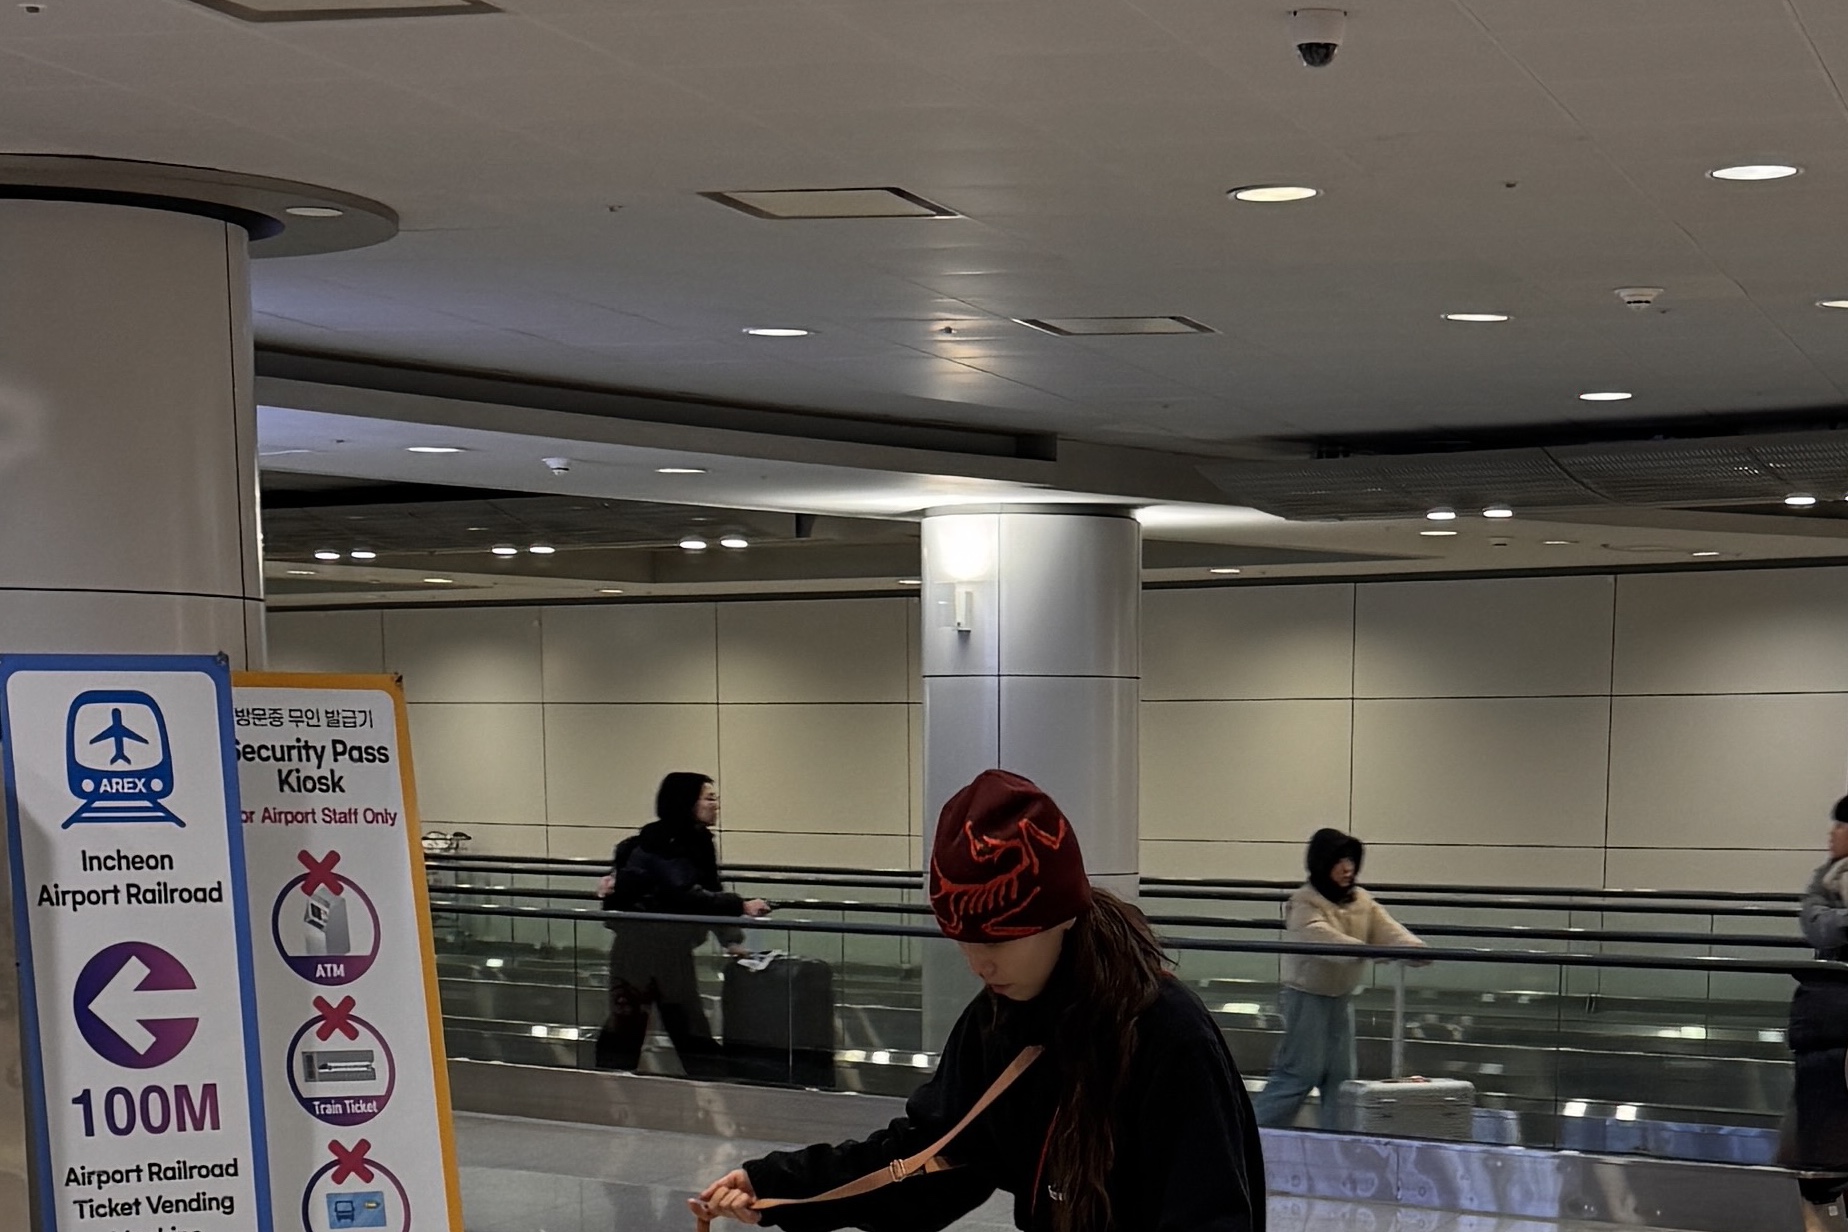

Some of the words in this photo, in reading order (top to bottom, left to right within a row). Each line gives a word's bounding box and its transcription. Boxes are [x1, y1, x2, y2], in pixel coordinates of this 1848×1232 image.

[288, 707, 321, 728] 무인
[325, 708, 373, 728] 발급기
[331, 738, 390, 763] Pass
[99, 777, 148, 793] AREX
[277, 768, 346, 793] Kiosk
[241, 810, 255, 824] or
[261, 806, 317, 826] Airport
[321, 806, 358, 824] Staff
[363, 807, 398, 827] Only
[81, 849, 174, 871] Incheon
[37, 883, 120, 912] Airport
[126, 880, 223, 905] Railroad
[315, 963, 346, 978] ATM
[71, 1083, 221, 1137] 100M
[312, 1100, 343, 1115] Train
[344, 1099, 379, 1114] Ticket
[64, 1165, 144, 1190] Airport
[147, 1158, 239, 1182] Railroad
[72, 1197, 142, 1219] Ticket
[145, 1191, 235, 1216] Vending
